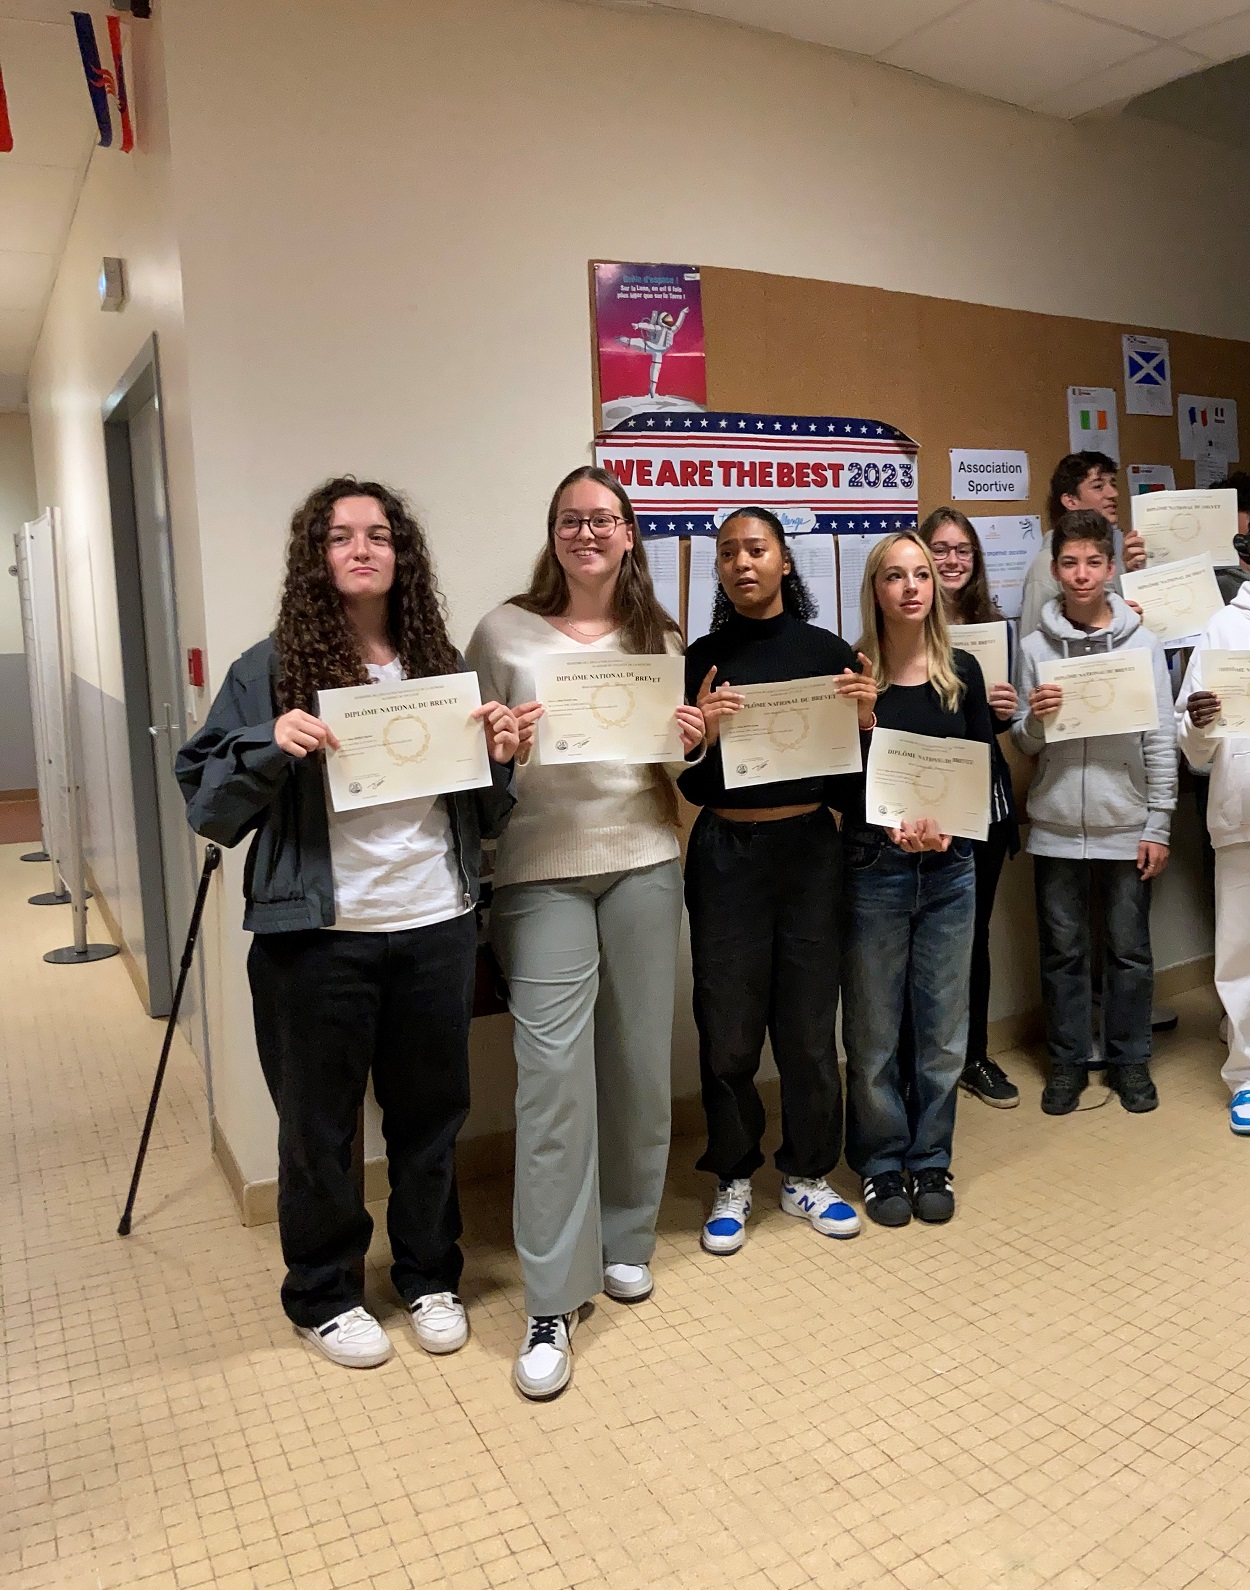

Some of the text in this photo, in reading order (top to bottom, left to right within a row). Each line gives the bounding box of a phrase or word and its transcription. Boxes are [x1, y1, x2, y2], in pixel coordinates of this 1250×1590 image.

[603, 459, 915, 489] WE ARE THE BEST 2023
[958, 461, 1022, 474] Association
[968, 480, 1015, 494] Sportive
[556, 673, 589, 682] DIPLÔME
[589, 672, 625, 680] NATIONAL
[767, 698, 799, 707] NATIONAL
[811, 693, 836, 701] BREVET
[344, 697, 458, 719] DIPLÔME NATIONAL DU BREVET
